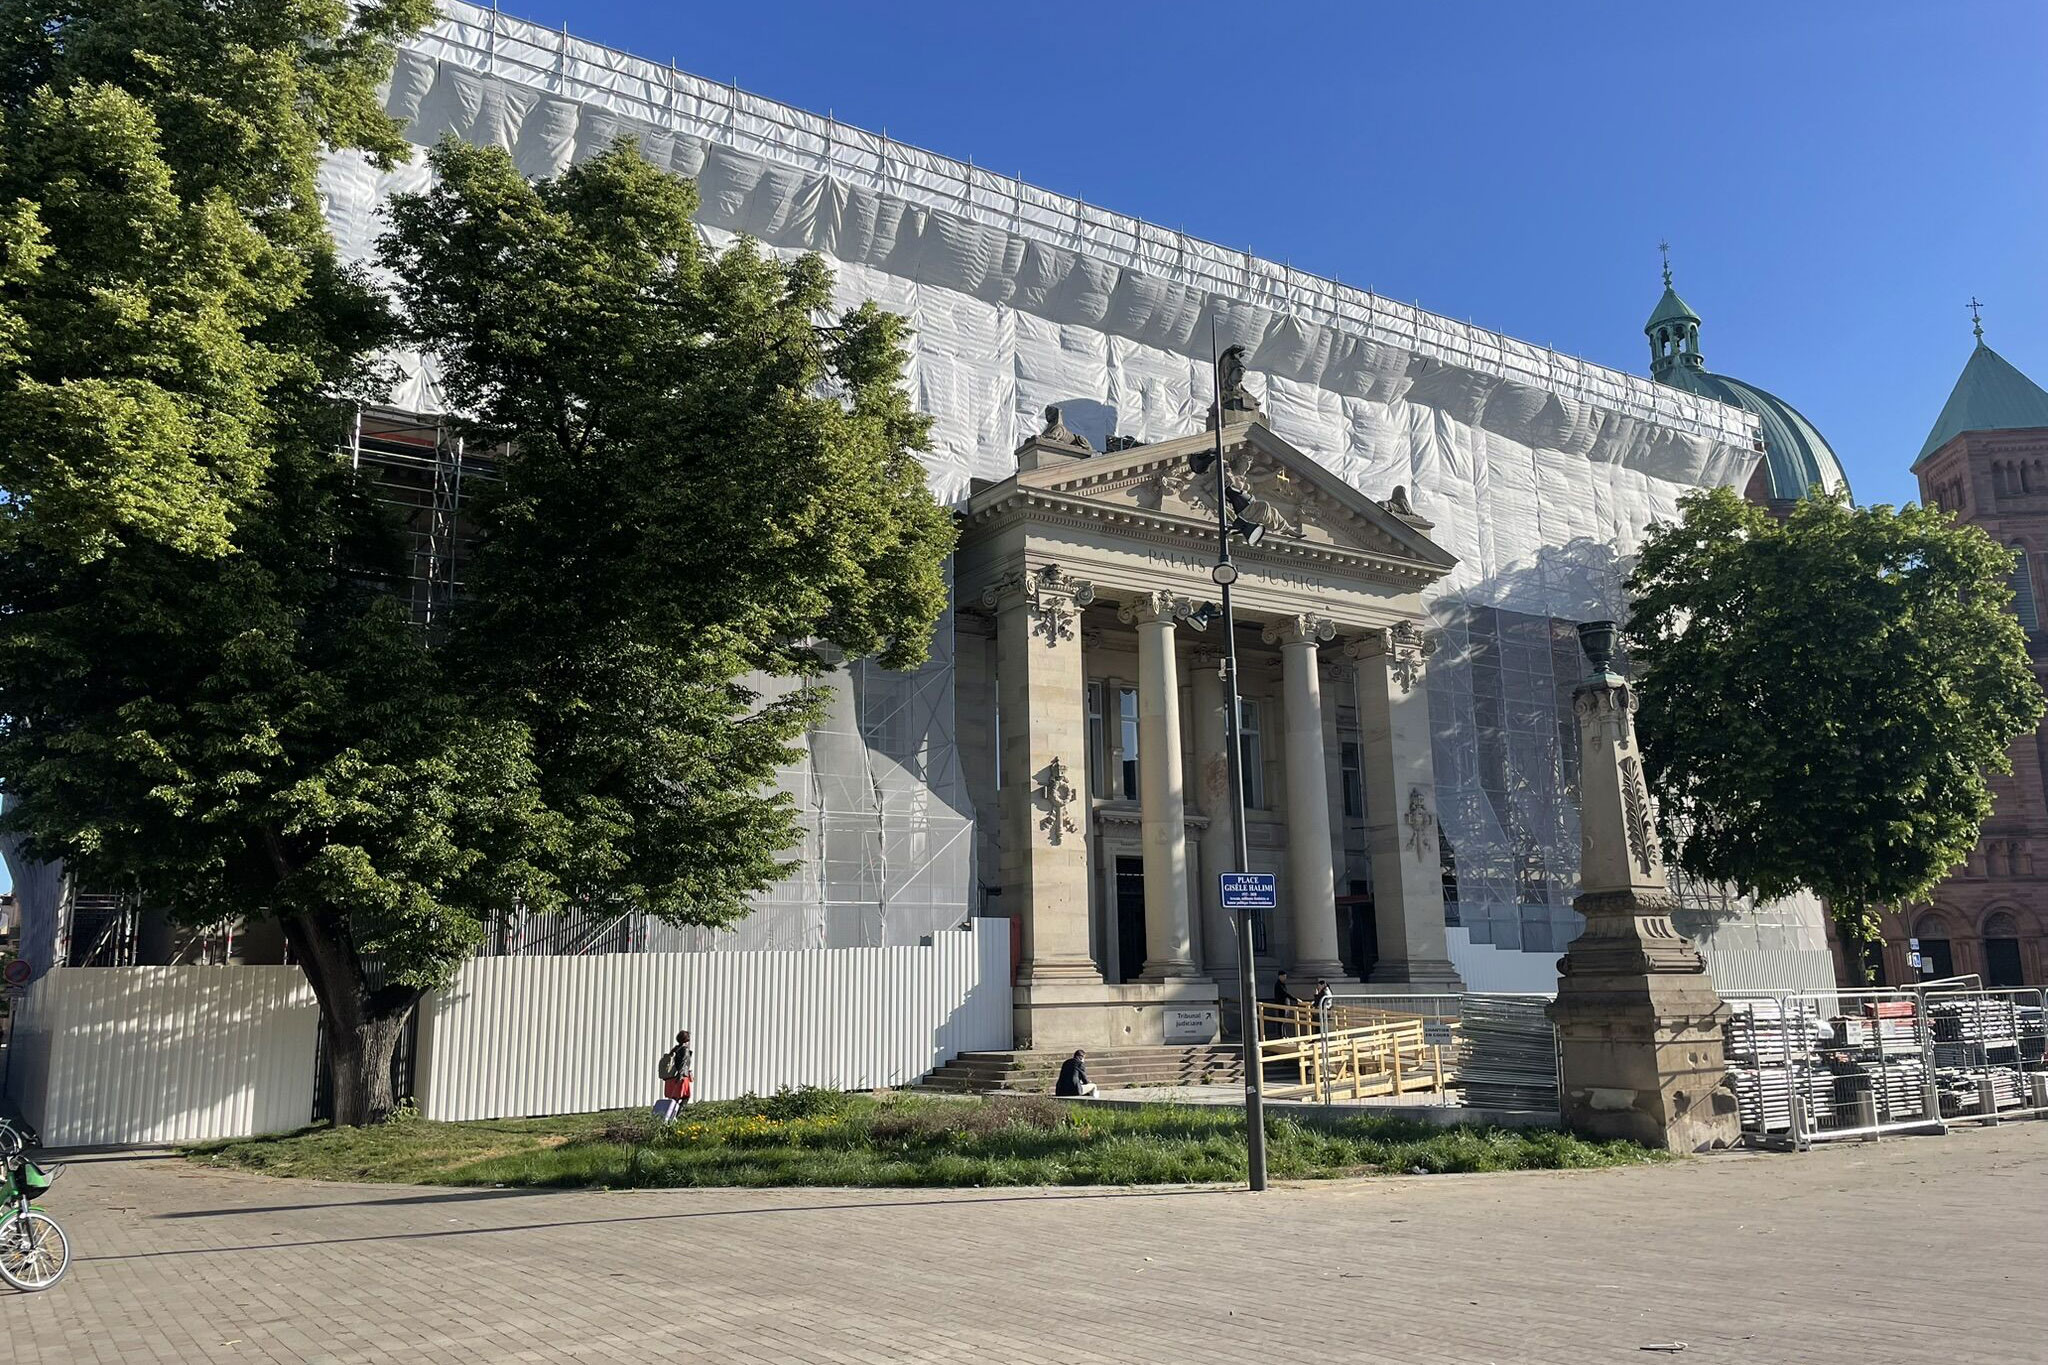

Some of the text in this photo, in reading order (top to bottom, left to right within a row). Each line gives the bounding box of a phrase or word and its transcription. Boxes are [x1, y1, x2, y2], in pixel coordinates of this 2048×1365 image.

[1148, 549, 1206, 573] PALAIS
[1257, 568, 1325, 593] JUSTICE
[1237, 876, 1259, 884] PLACE
[1224, 883, 1273, 892] GISÈLE HALIMI
